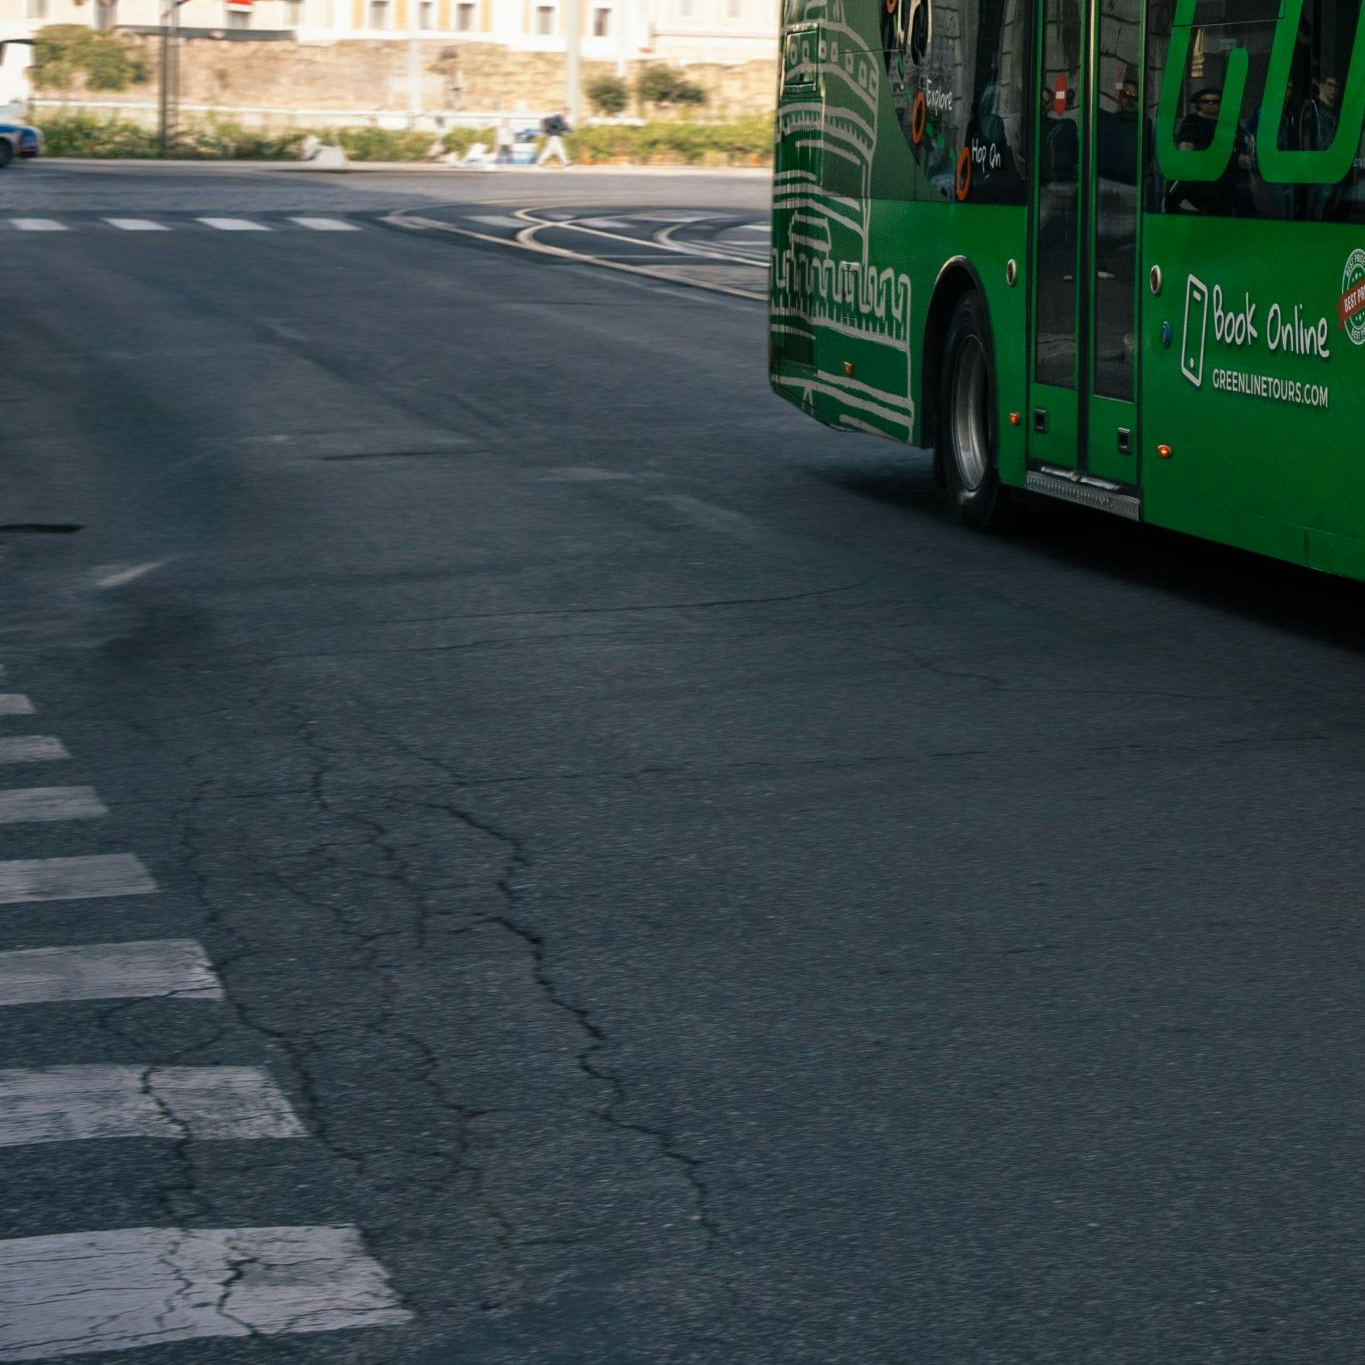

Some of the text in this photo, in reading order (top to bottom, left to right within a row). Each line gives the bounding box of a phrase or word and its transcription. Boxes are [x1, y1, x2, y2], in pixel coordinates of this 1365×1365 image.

[926, 78, 954, 115] Explore
[972, 138, 1001, 173] Hop On
[1212, 283, 1330, 358] Book Online
[1343, 292, 1357, 313] BEST
[1212, 368, 1329, 408] GREENLINETOURS.COM
